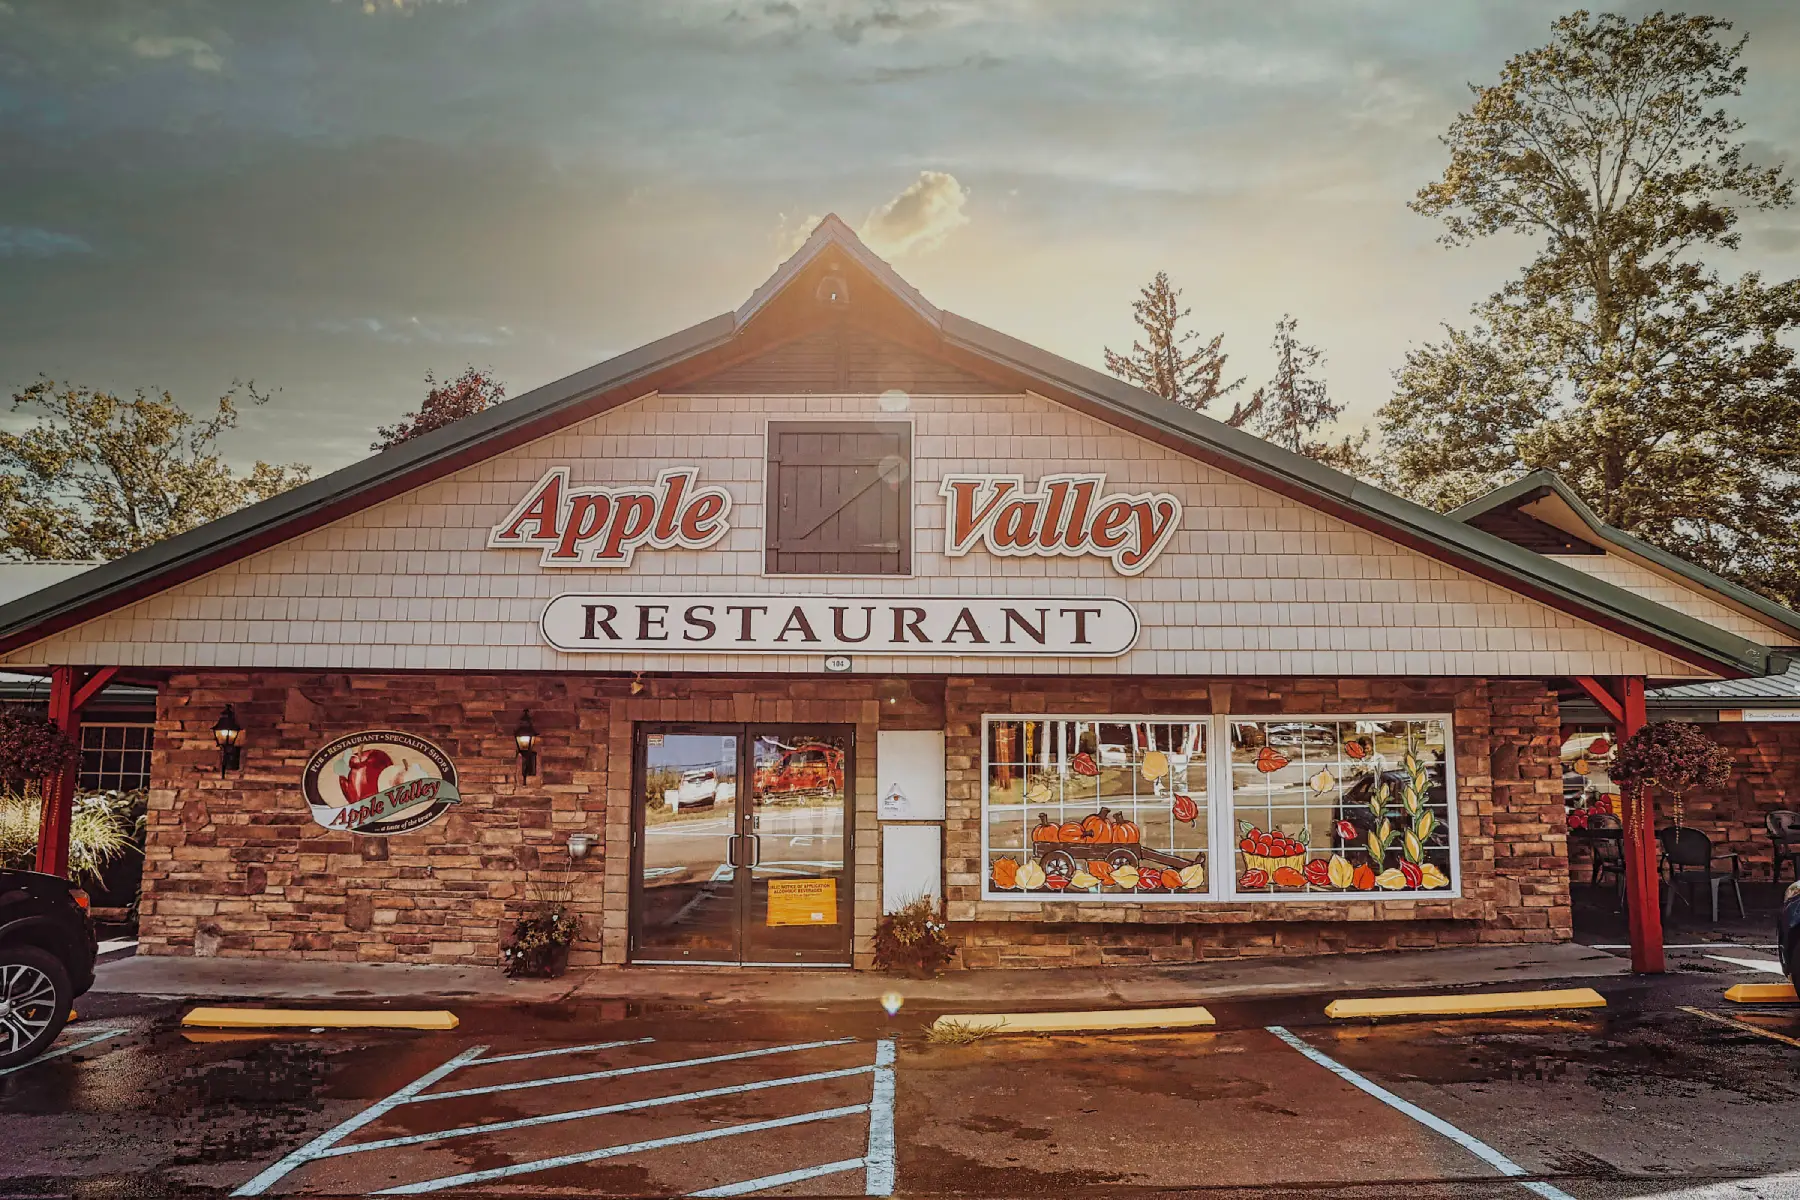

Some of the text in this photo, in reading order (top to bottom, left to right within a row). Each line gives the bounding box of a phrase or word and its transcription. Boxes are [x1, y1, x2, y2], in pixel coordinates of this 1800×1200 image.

[498, 474, 1174, 566] Apple Valley
[579, 604, 1103, 646] RESTAURANT
[310, 734, 449, 773] PUB RESTAURANT SPECIALITY SHOPS
[328, 778, 441, 829] Apple Valley
